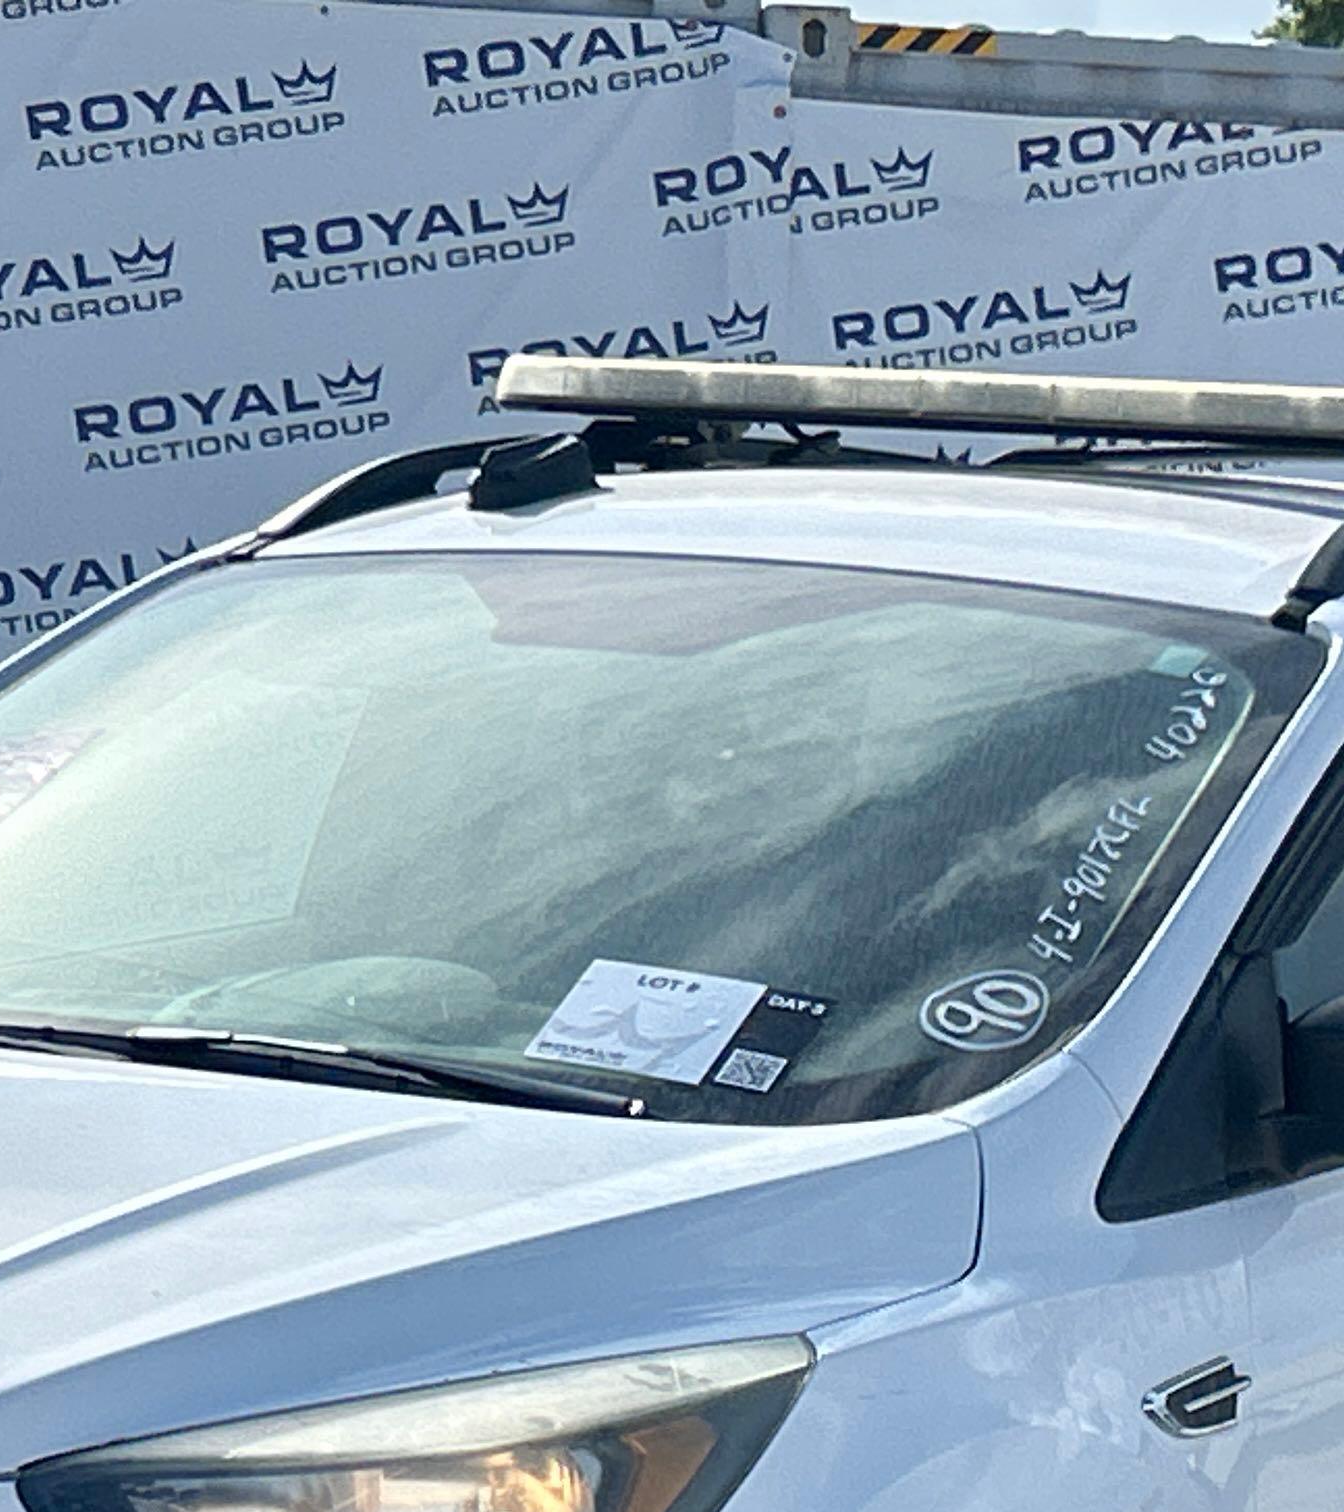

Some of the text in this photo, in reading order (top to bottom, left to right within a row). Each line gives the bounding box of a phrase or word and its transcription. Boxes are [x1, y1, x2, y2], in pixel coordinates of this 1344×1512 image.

[423, 23, 668, 86] ROYAL
[24, 77, 274, 140] ROYAL
[434, 57, 736, 115] AUCTION GROUP
[36, 111, 345, 170] AUCTION GROUP
[1025, 140, 1322, 200] AUCTION GROUP
[261, 199, 507, 263] ROYAL
[811, 196, 940, 233] GROUP
[272, 233, 576, 292] AUCTION GROUP
[50, 287, 183, 324] GROUP
[830, 286, 1070, 351] ROYAL
[845, 319, 1138, 369] CTION GROUP
[73, 378, 321, 442] ROYAL
[84, 411, 391, 471] AUCTION GROUP
[636, 974, 685, 992] LOT
[936, 979, 1041, 1033] 90
